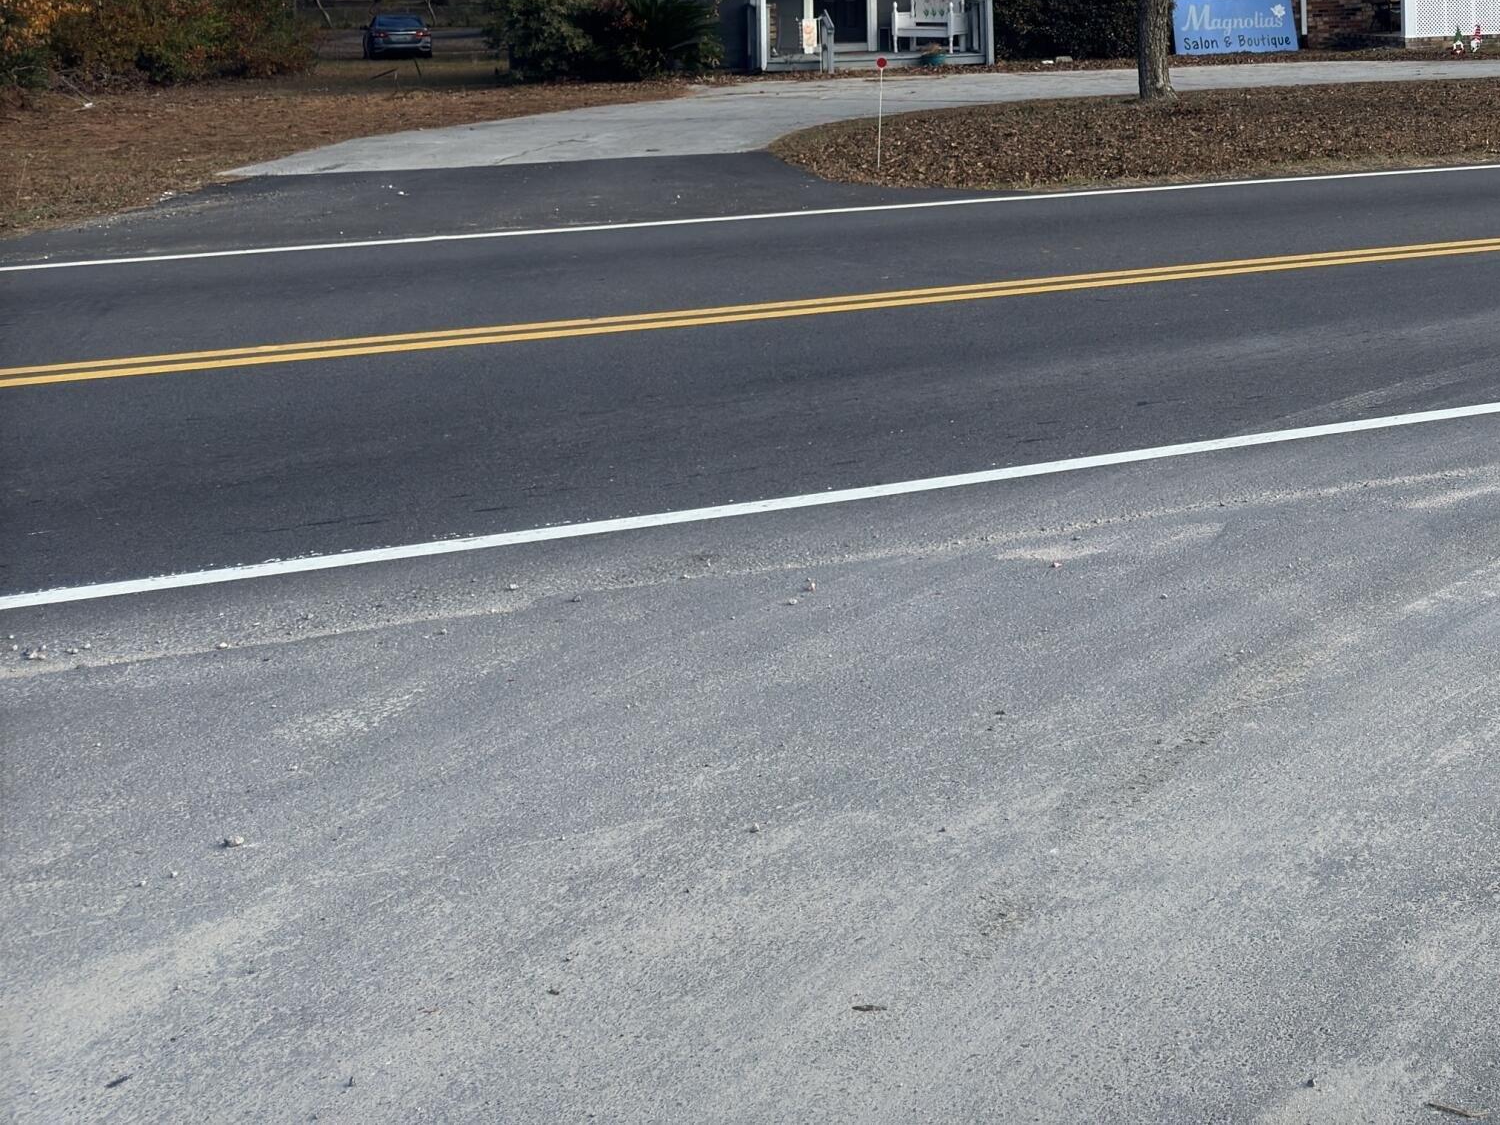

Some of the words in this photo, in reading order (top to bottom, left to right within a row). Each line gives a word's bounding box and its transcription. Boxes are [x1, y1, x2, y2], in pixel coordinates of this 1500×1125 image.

[1181, 4, 1283, 35] Magnolias
[1184, 37, 1219, 50] Salon
[1224, 36, 1232, 48] &
[1238, 34, 1291, 48] Boutique
